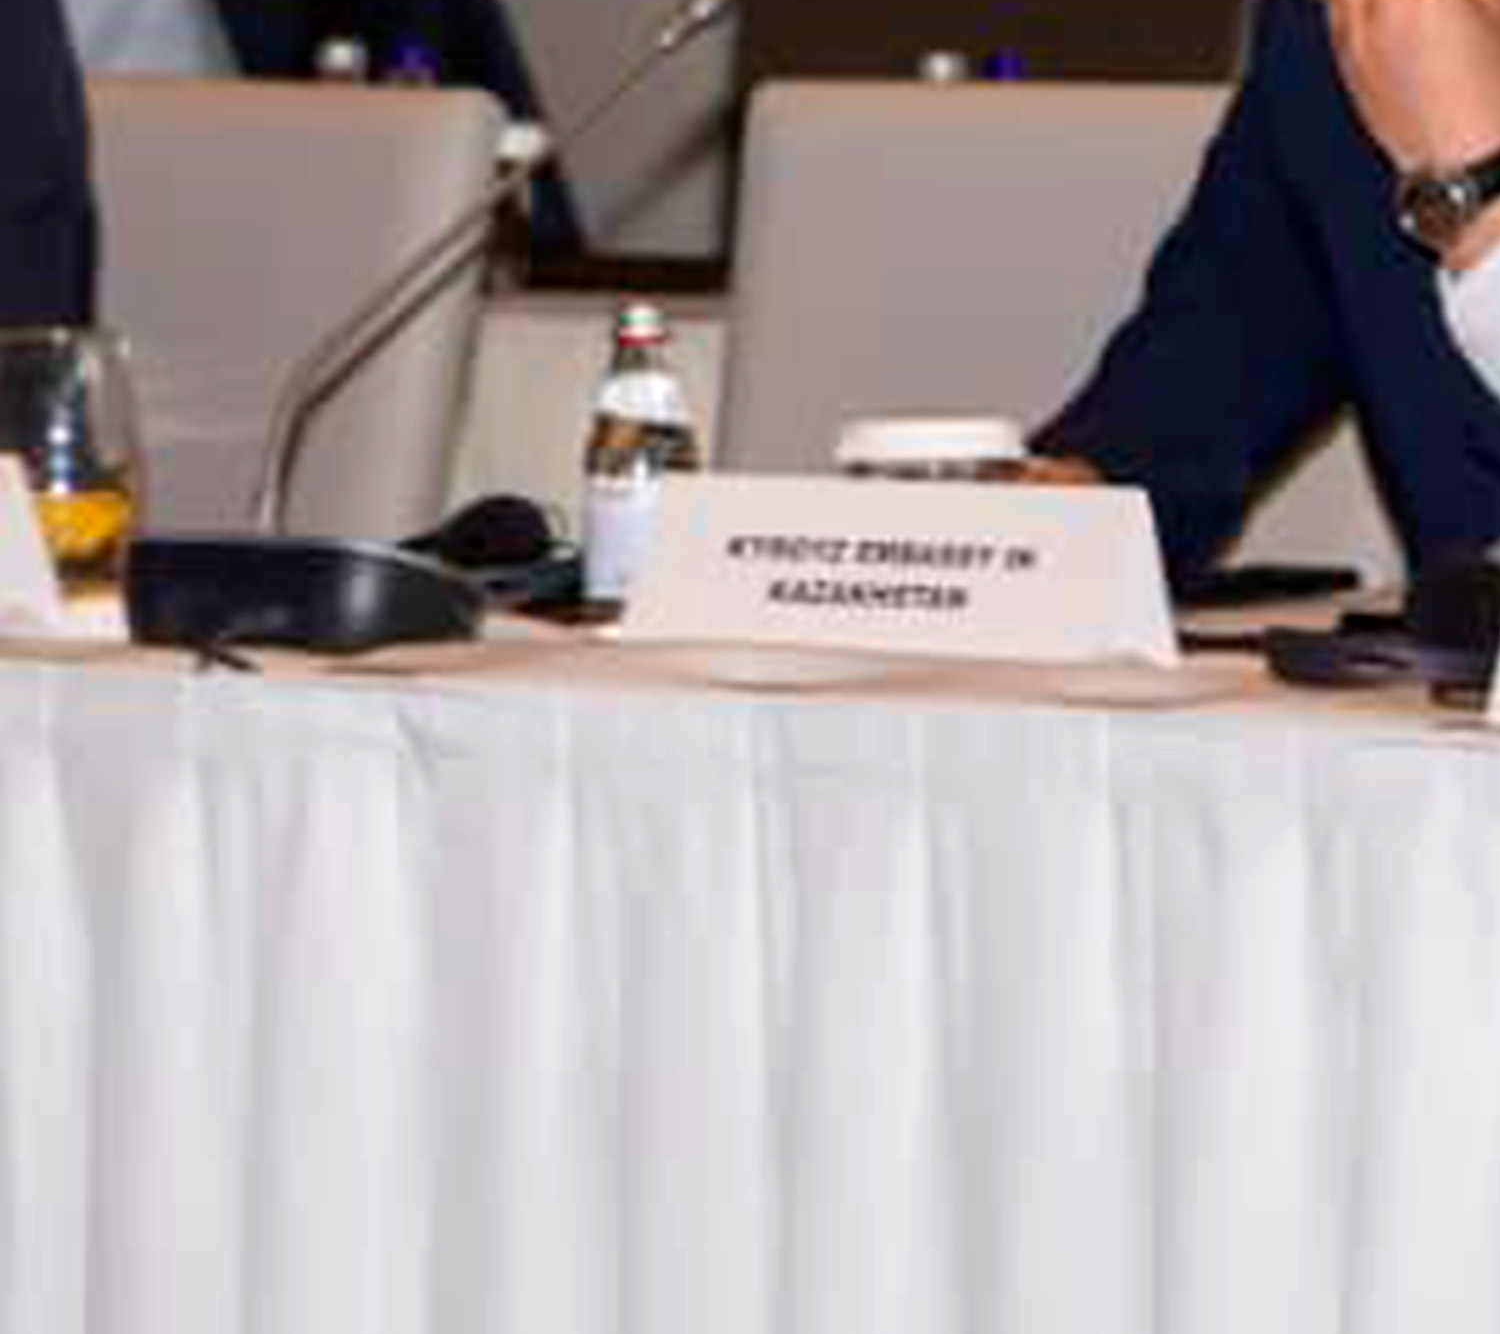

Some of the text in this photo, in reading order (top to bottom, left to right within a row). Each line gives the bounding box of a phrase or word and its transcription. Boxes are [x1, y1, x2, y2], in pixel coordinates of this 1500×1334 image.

[855, 536, 992, 568] EMBASSY
[1005, 548, 1037, 571] IN
[768, 579, 968, 609] KAZAKHSTAN
